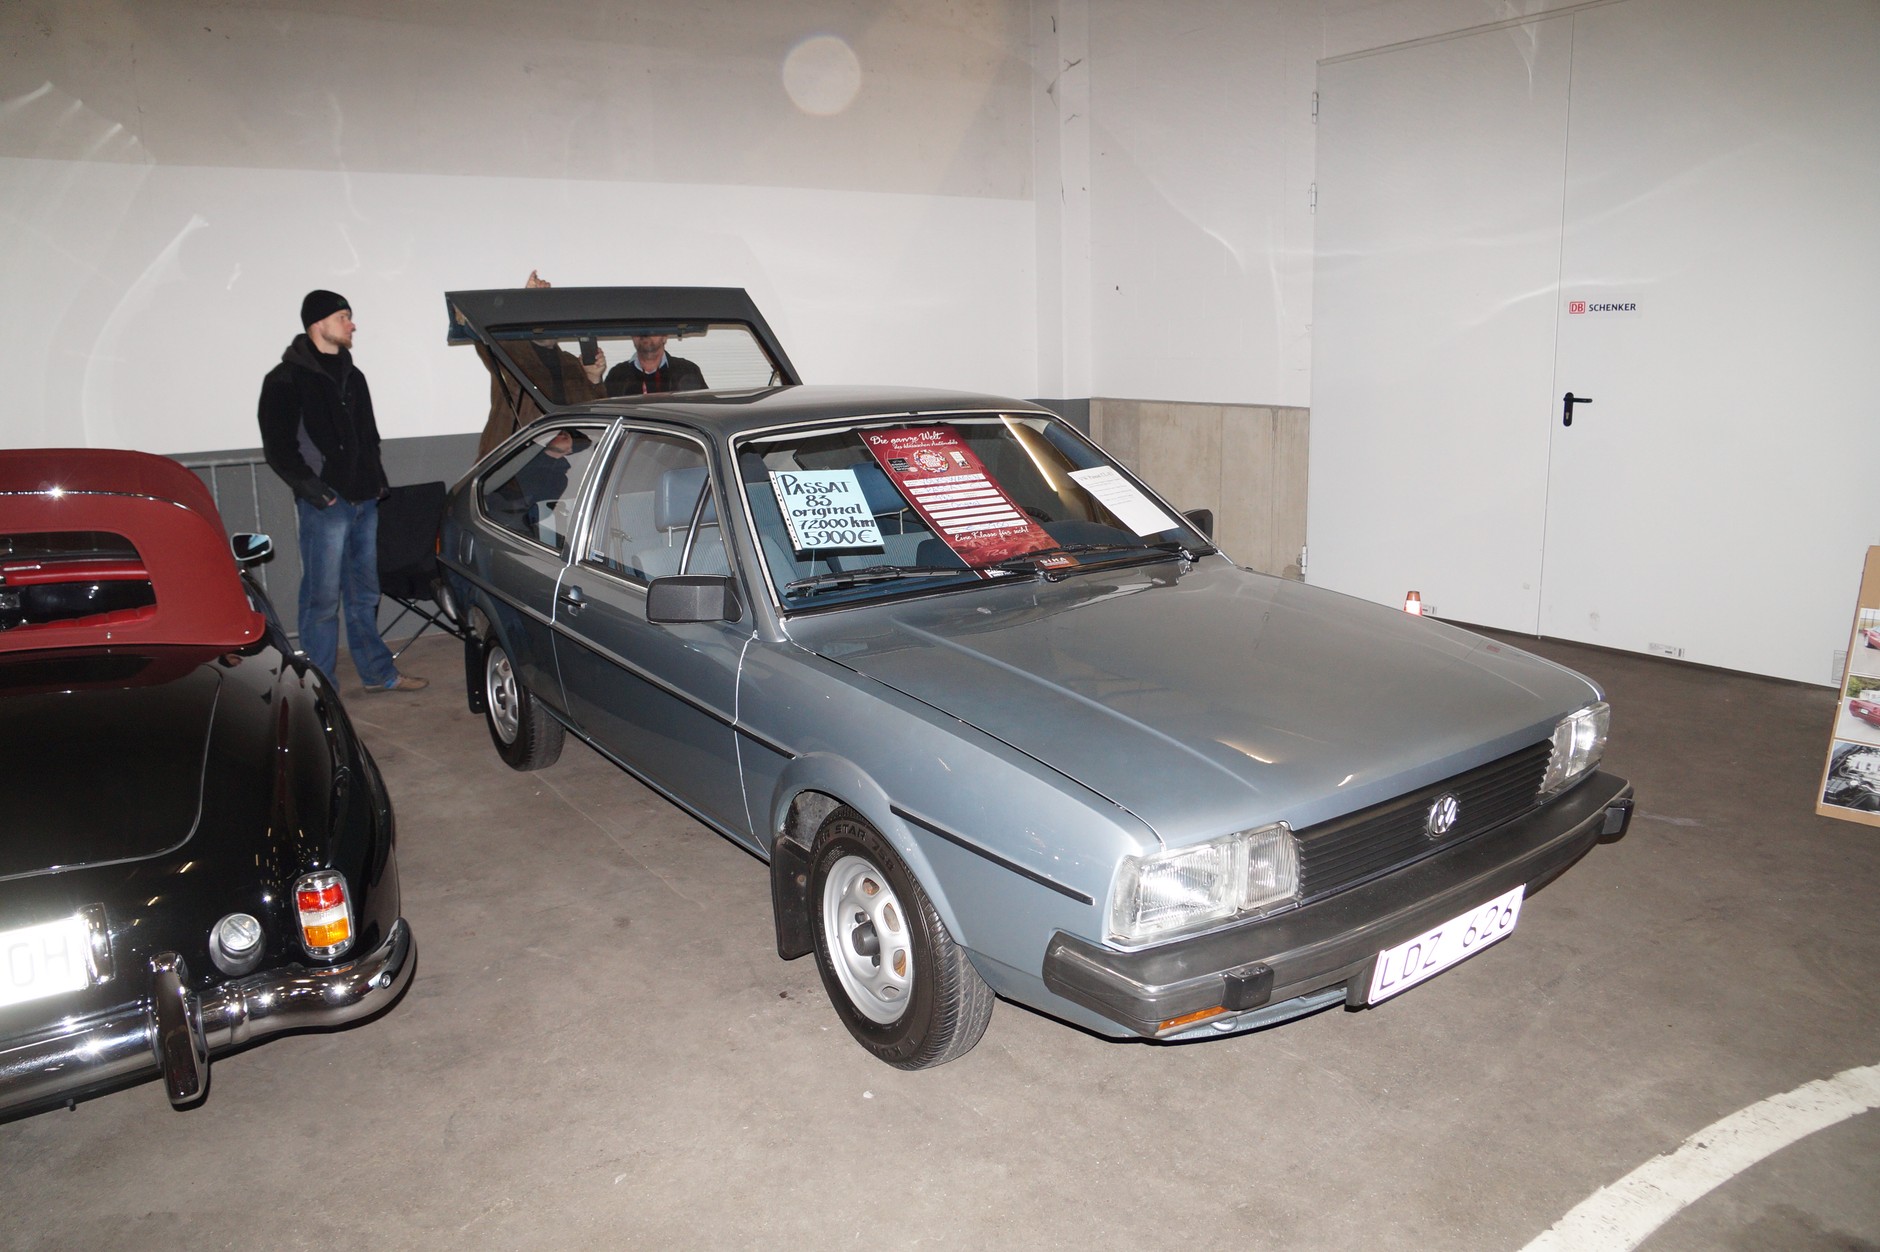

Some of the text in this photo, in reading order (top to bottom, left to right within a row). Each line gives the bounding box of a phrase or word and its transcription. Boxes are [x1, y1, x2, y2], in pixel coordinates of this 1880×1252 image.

[1570, 302, 1636, 313] DB SCHENKER
[870, 431, 944, 446] Die ganze Welt
[776, 474, 851, 495] PASSAT
[805, 495, 832, 507] 83
[792, 504, 863, 518] original
[849, 516, 876, 527] km
[955, 533, 972, 542] Eine
[972, 531, 998, 540] Klasse
[998, 528, 1012, 540] für
[835, 824, 867, 841] STAR
[1379, 895, 1515, 990] LDZ 626
